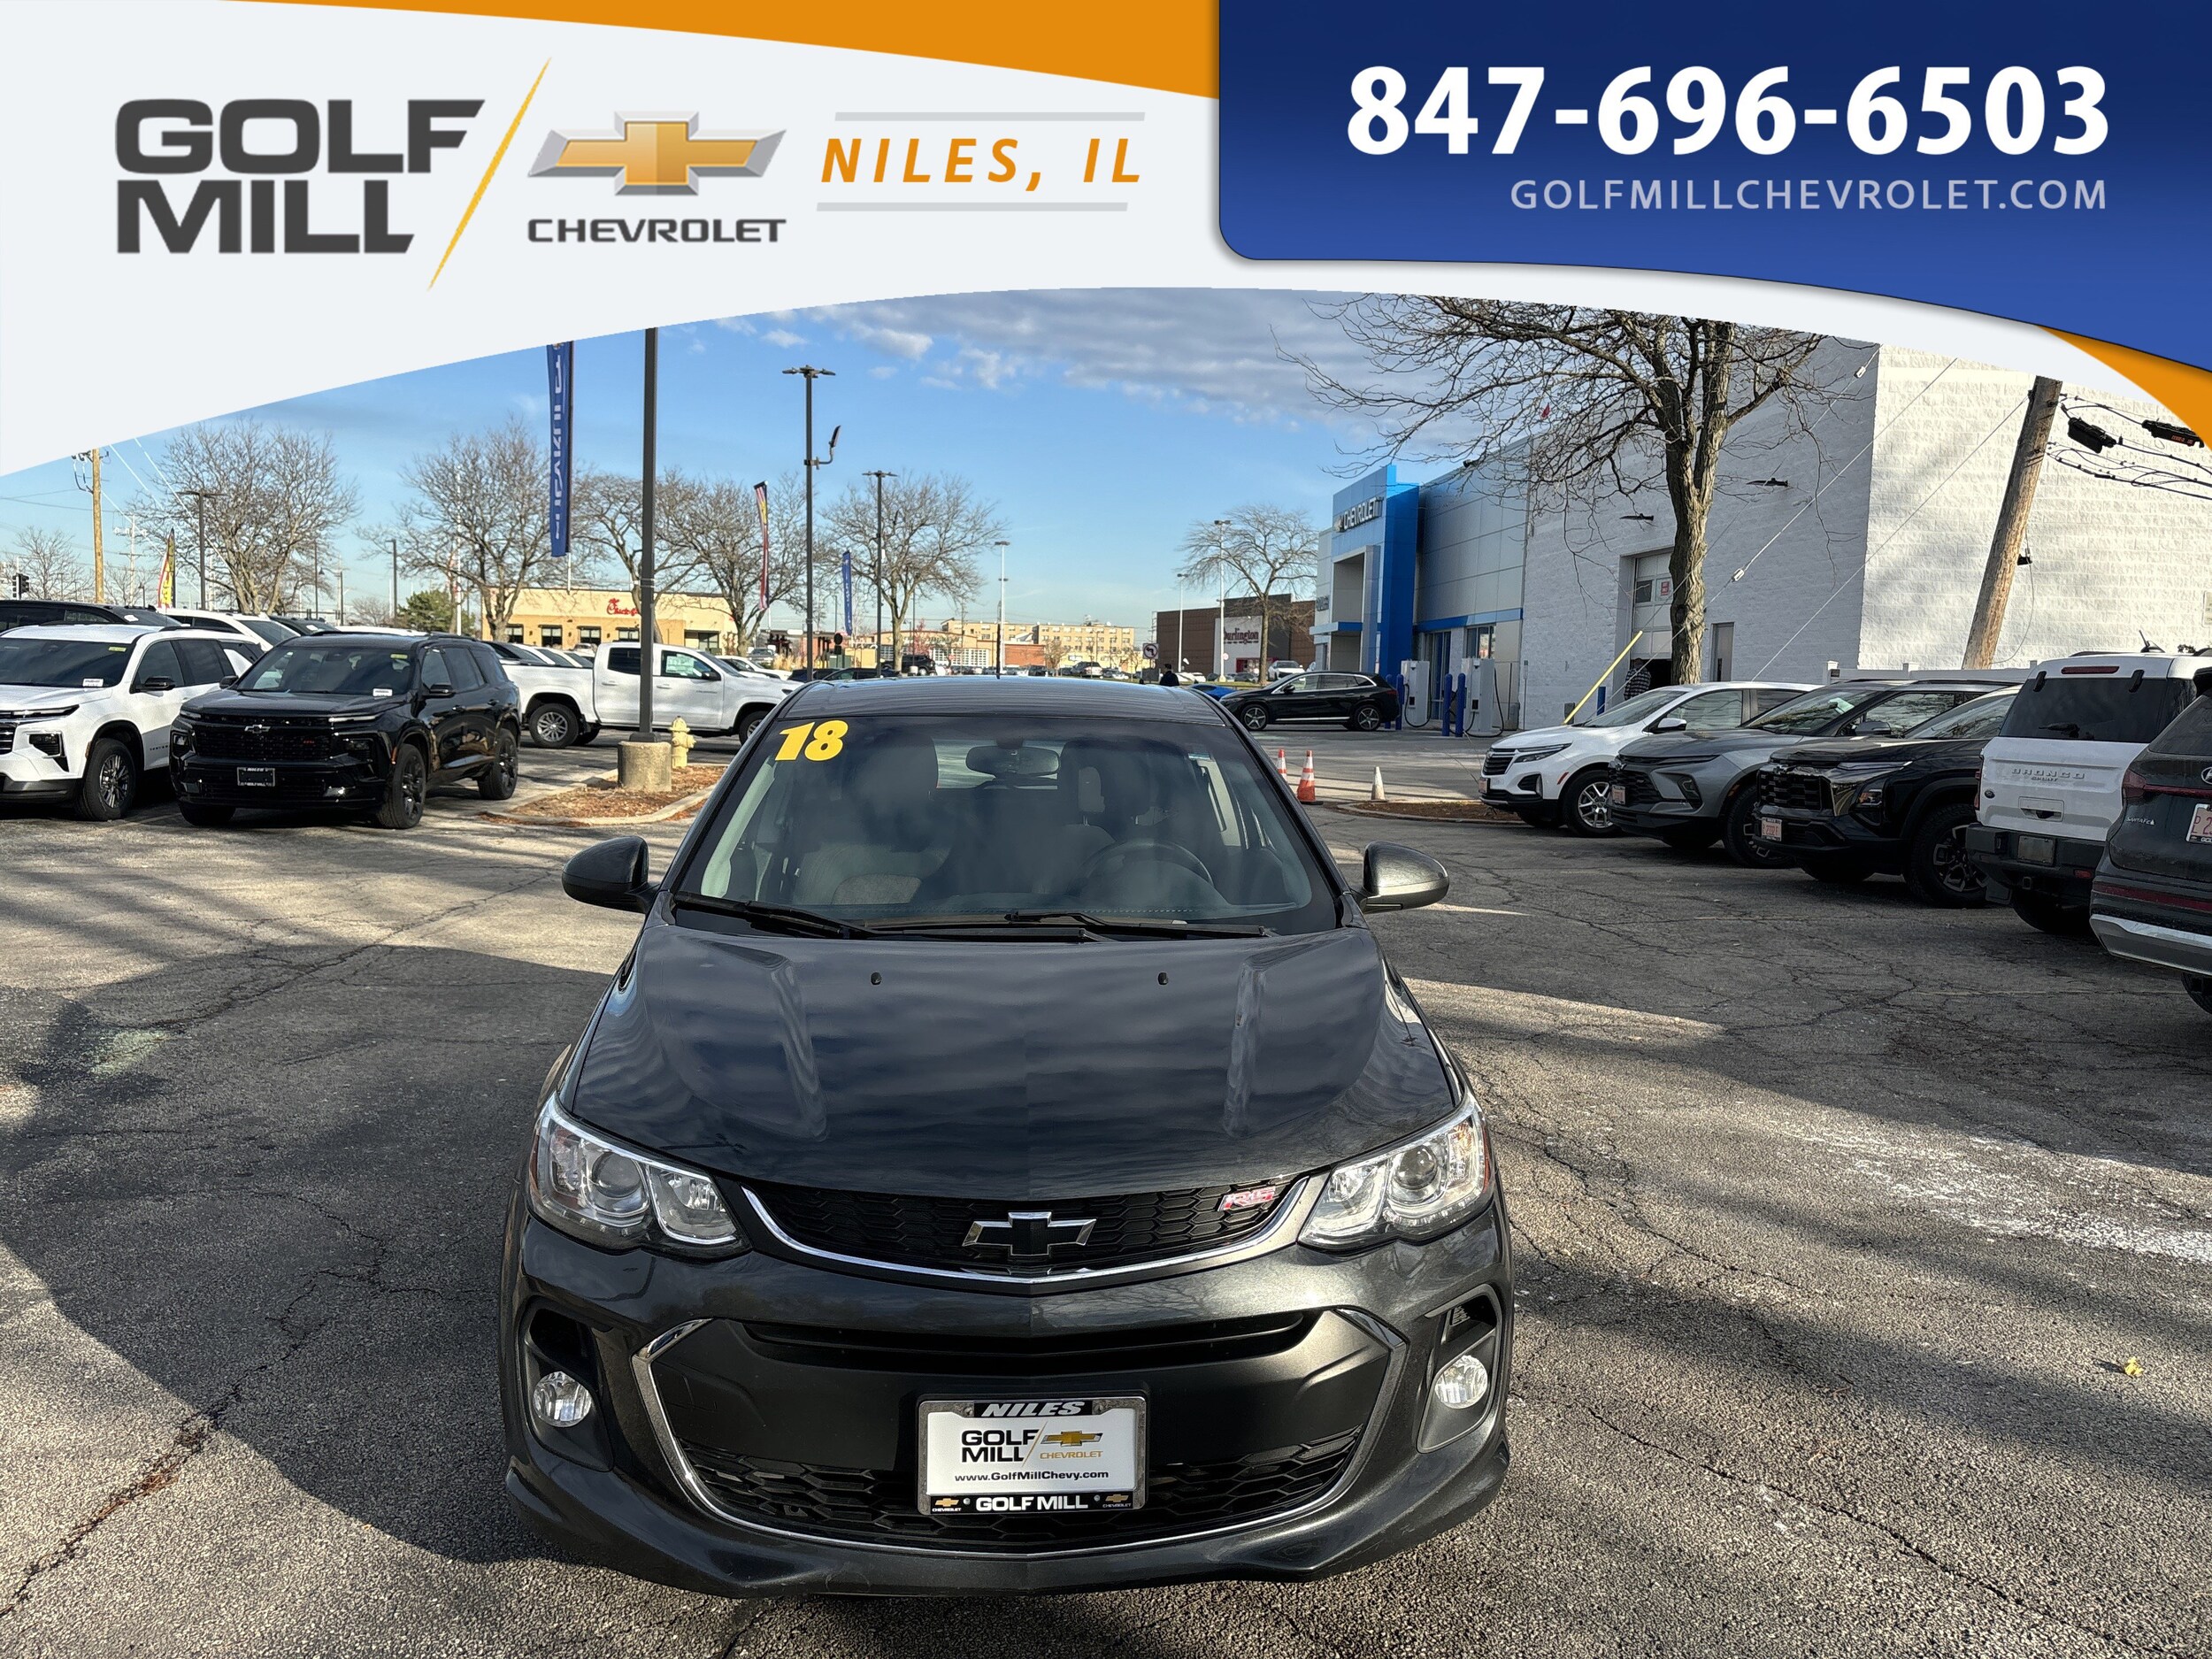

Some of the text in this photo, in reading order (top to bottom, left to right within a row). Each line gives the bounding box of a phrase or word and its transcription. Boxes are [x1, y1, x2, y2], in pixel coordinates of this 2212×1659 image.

[1344, 496, 1379, 530] CHEVROLET
[775, 720, 849, 761] 18
[981, 1402, 1085, 1417] NILES
[961, 1429, 1040, 1447] GOLF
[961, 1447, 1025, 1463] MILL
[1040, 1450, 1103, 1459] CHEVROLET
[955, 1471, 1110, 1482] www.GolfMillChevy.com
[975, 1495, 1089, 1511] GOLF MILL
